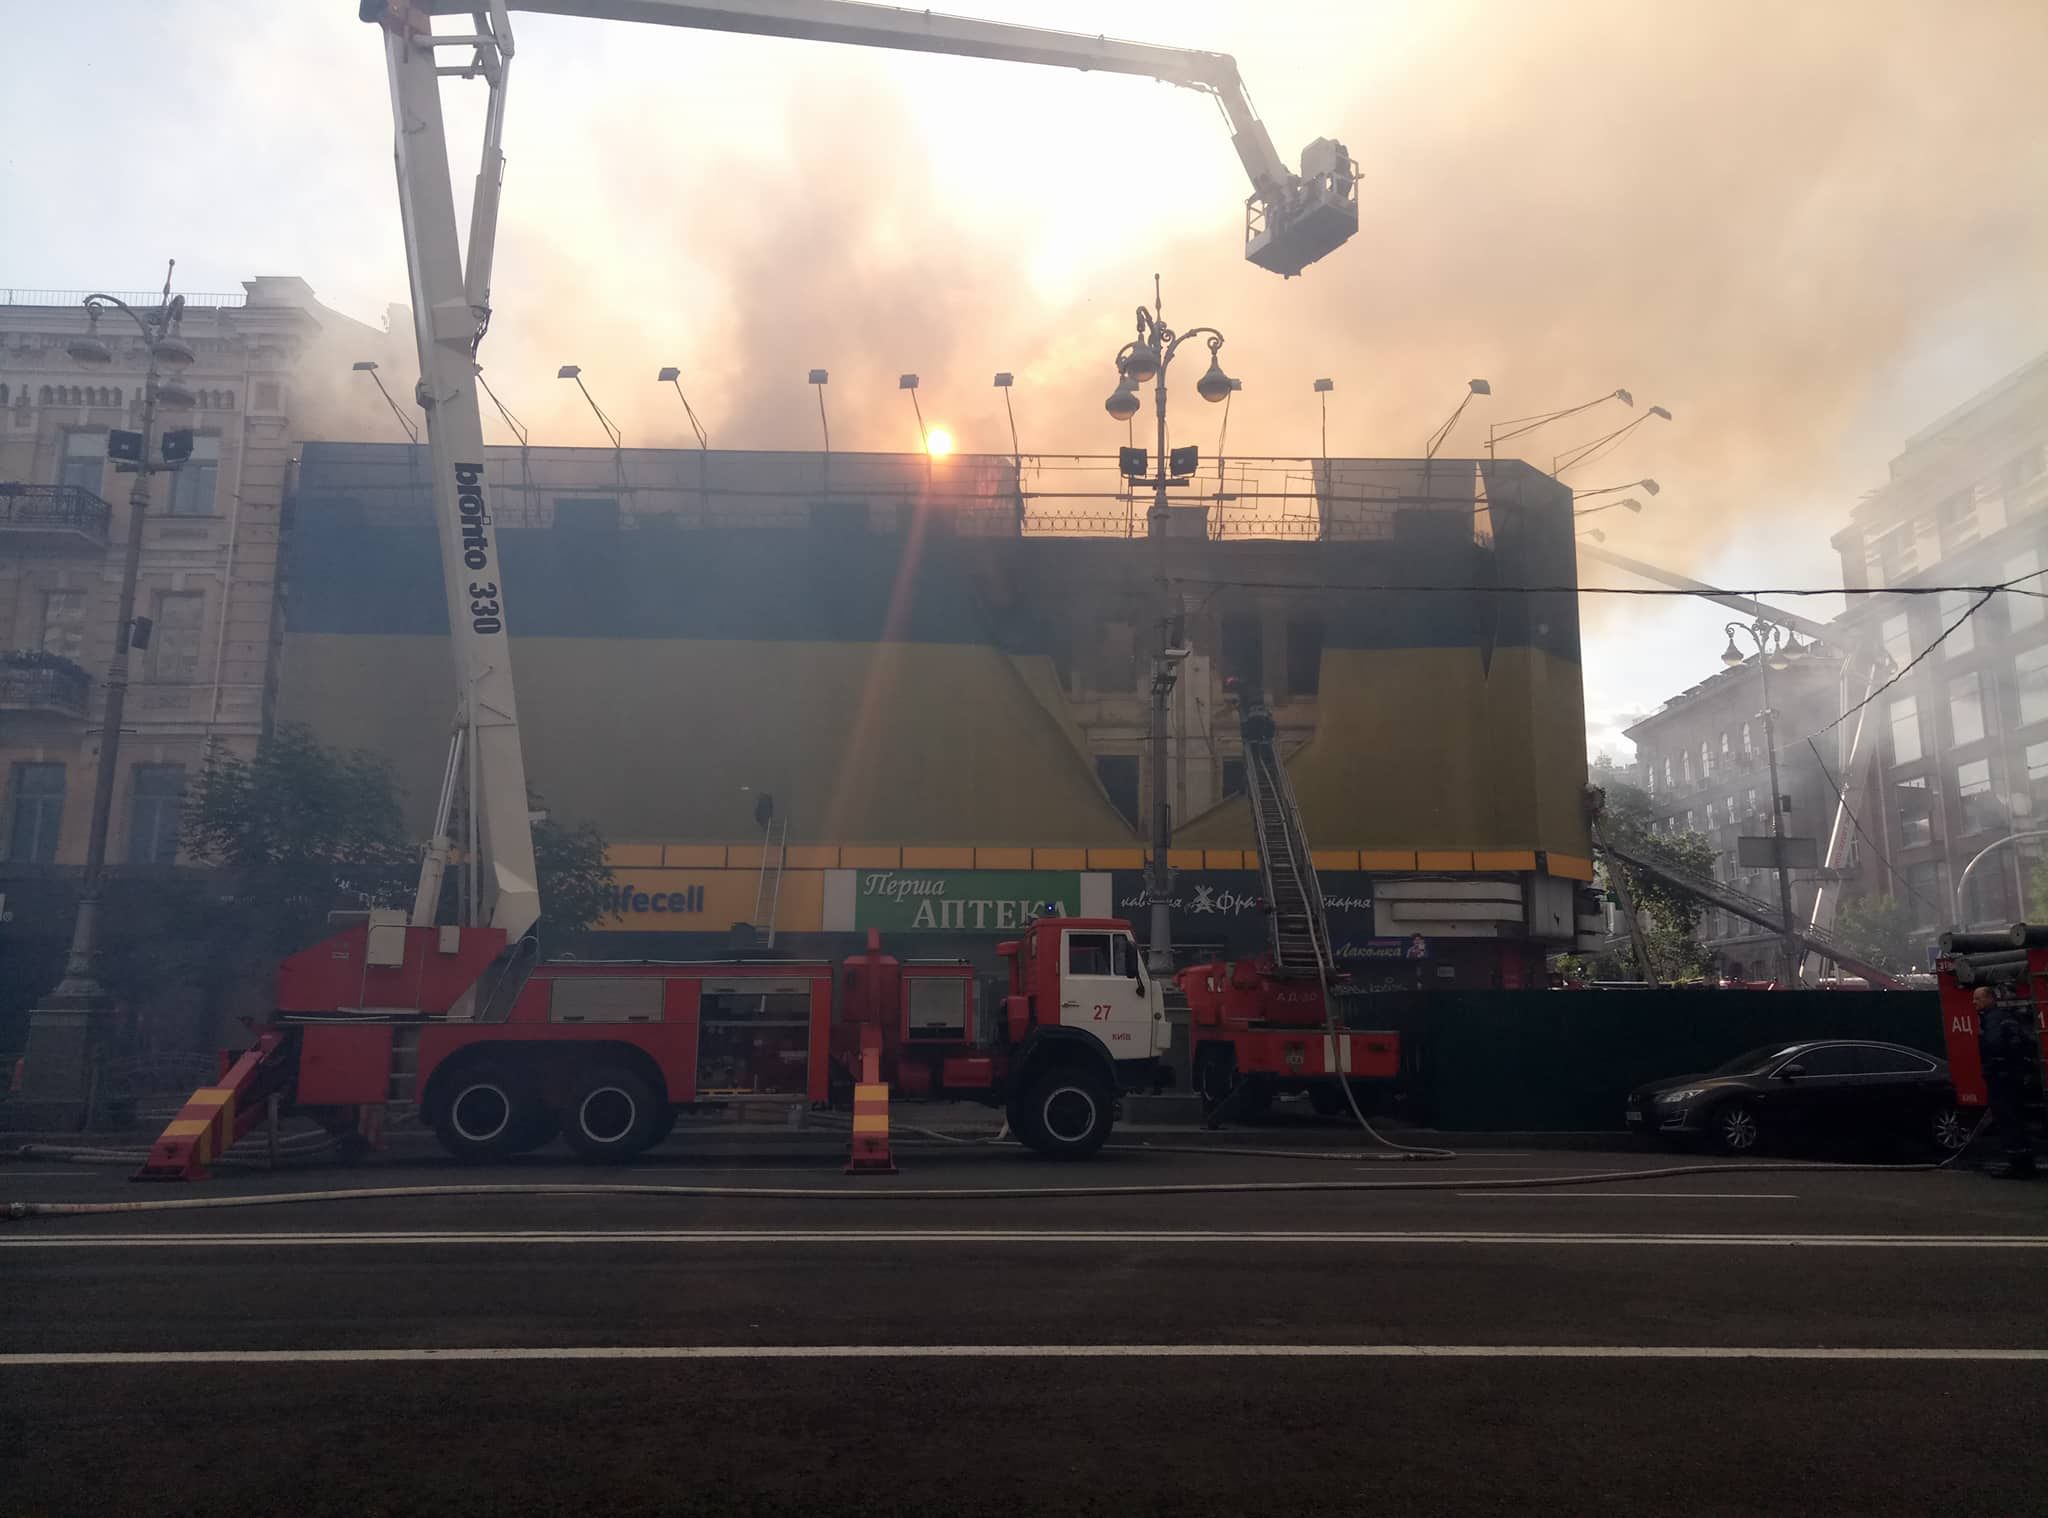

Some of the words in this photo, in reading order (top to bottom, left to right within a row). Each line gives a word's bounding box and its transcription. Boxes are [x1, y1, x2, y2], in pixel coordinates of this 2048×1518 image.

[454, 462, 491, 570] bronto
[469, 582, 501, 634] 330
[602, 884, 704, 912] ifecell
[864, 872, 945, 902] Перша
[1093, 1005, 1112, 1021] 27
